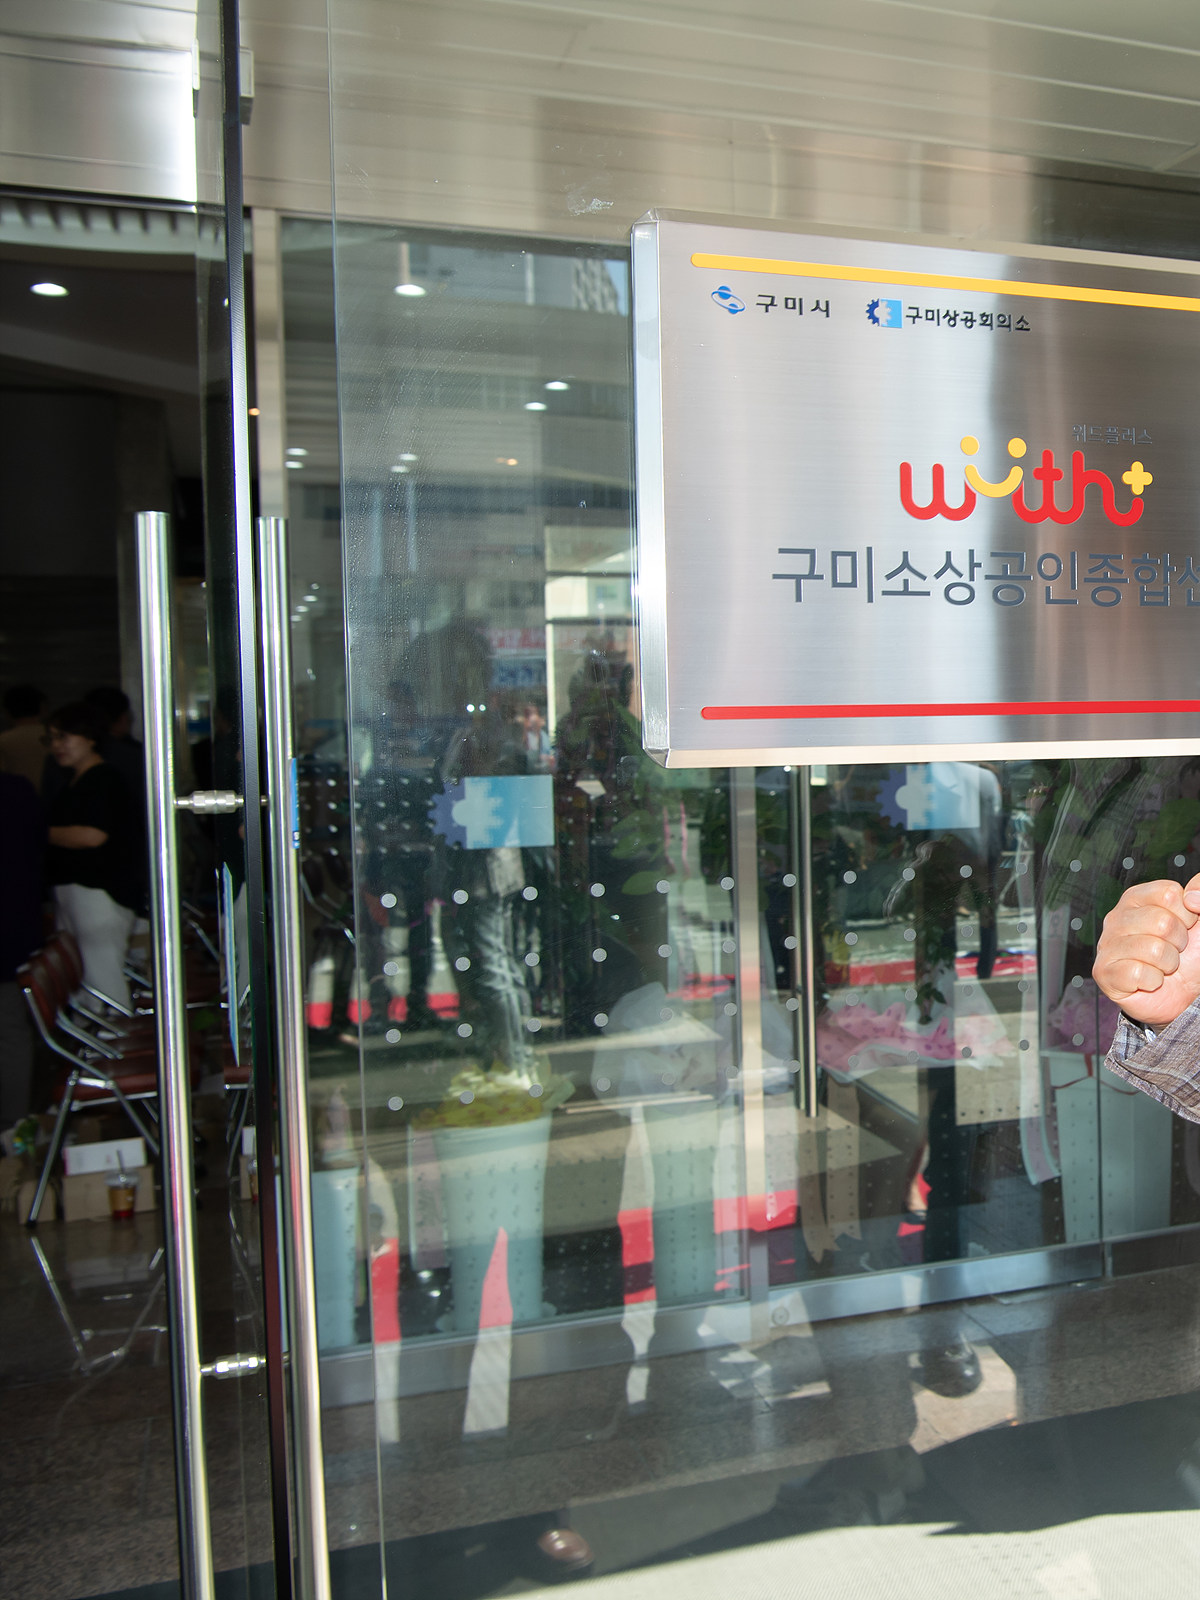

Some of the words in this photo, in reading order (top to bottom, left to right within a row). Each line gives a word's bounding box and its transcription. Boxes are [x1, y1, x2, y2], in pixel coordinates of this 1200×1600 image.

[755, 293, 832, 318] 구미시
[905, 306, 1031, 333] 구미상공회의소
[1071, 424, 1153, 446] 위드플러스
